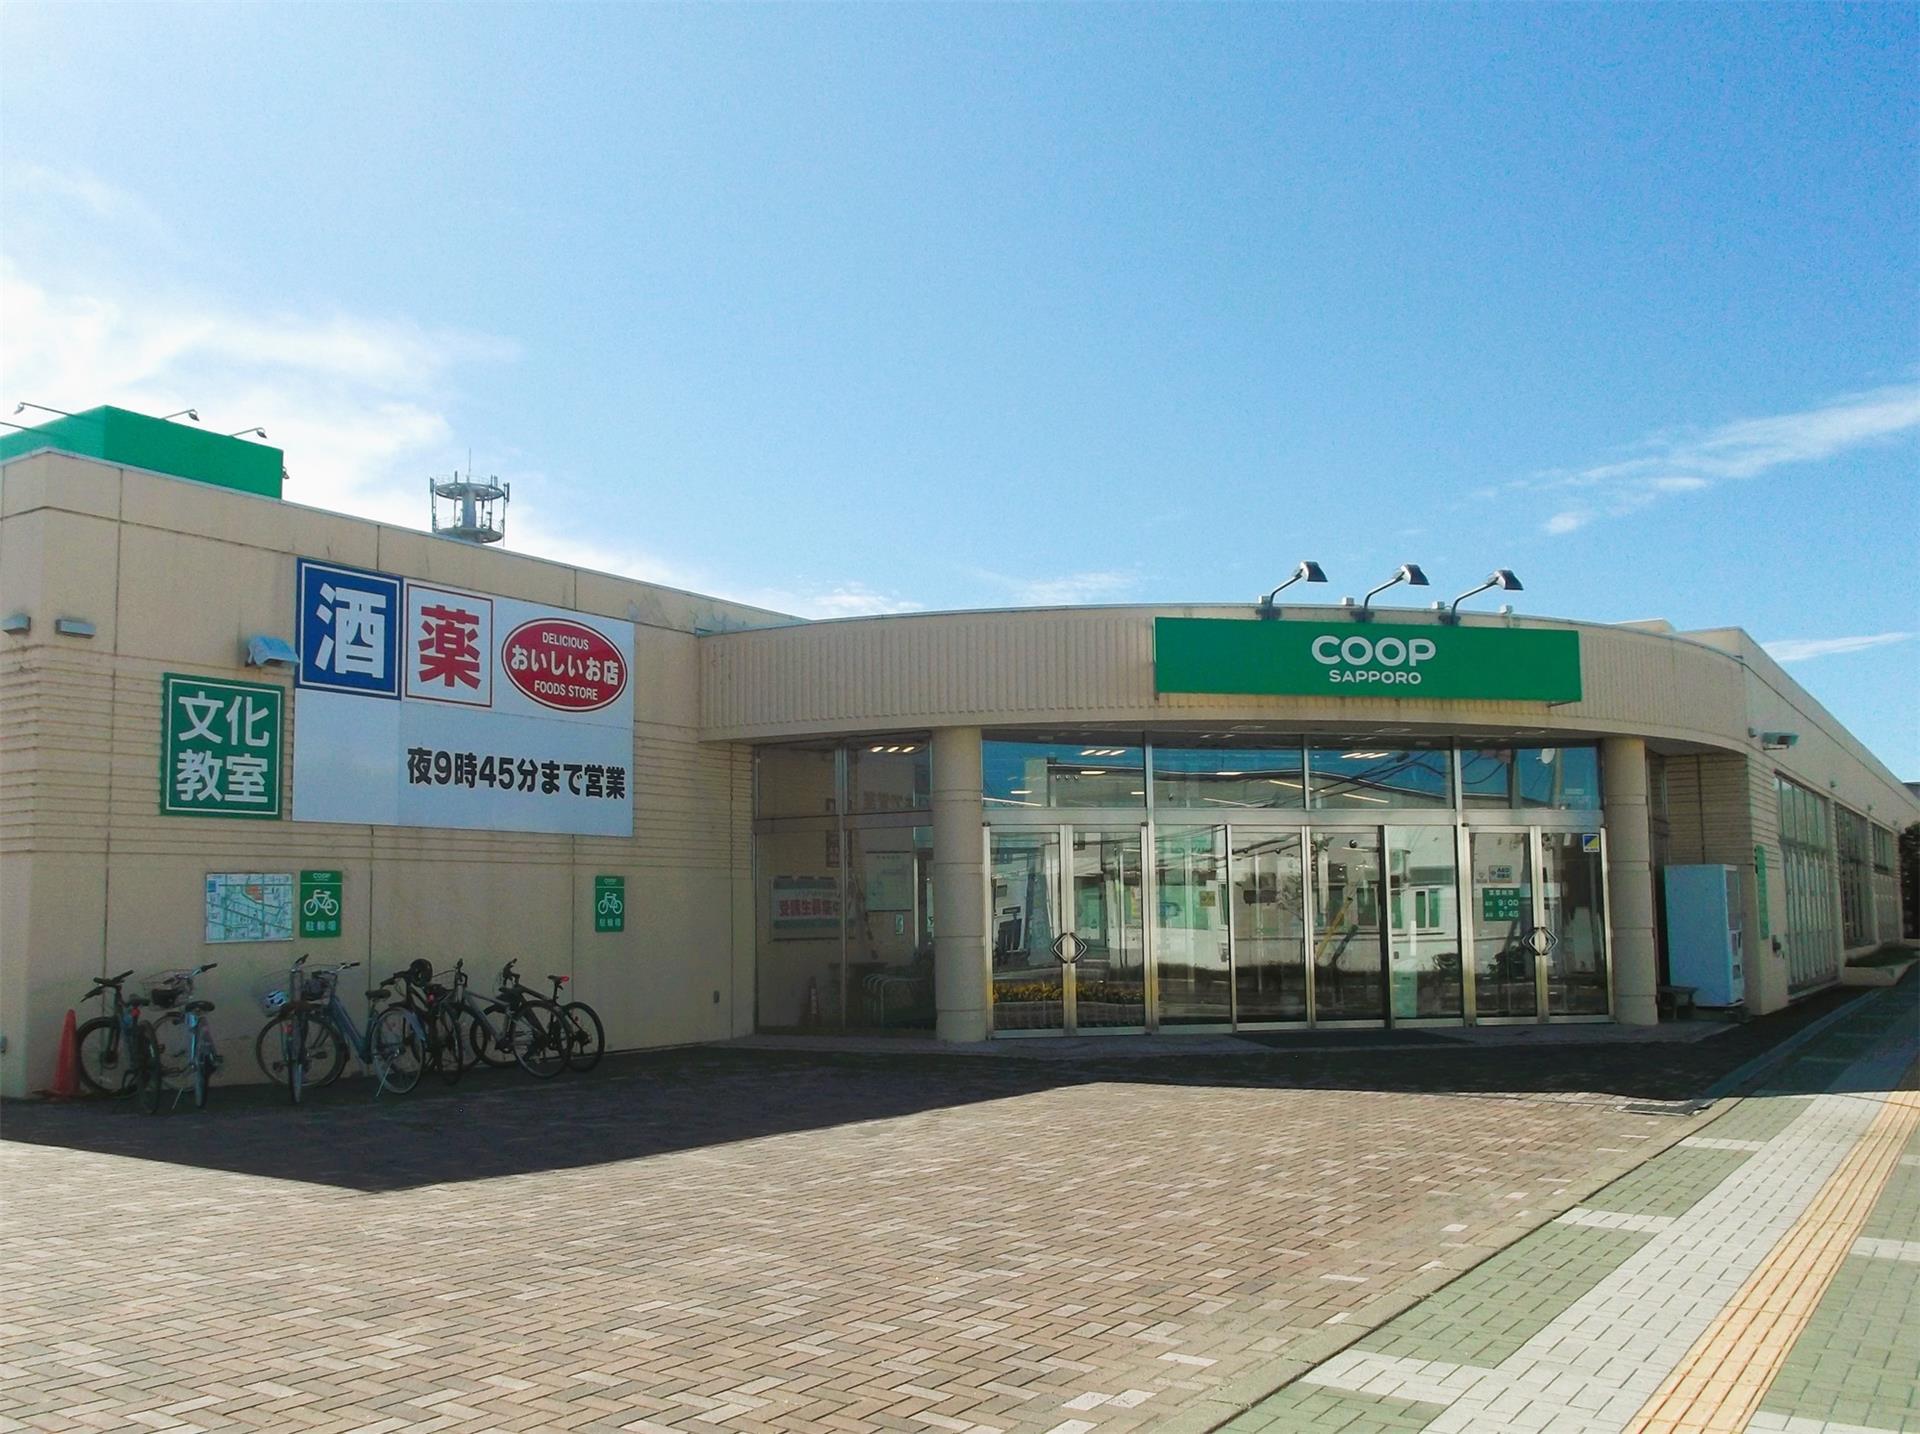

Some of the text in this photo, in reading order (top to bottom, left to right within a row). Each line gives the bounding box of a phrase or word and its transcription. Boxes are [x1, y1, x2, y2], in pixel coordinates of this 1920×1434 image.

[315, 582, 387, 679] 酒
[418, 604, 481, 690] 薬
[542, 631, 589, 650] DELICIOUS
[1311, 635, 1436, 667] COOP
[510, 644, 619, 686] おいしいお店
[1329, 669, 1421, 685] SAPPORO
[534, 679, 598, 701] FOODS STORE
[178, 690, 270, 747] 文化
[176, 748, 268, 803] 教室
[407, 747, 625, 800] 夜9時45分まで営業
